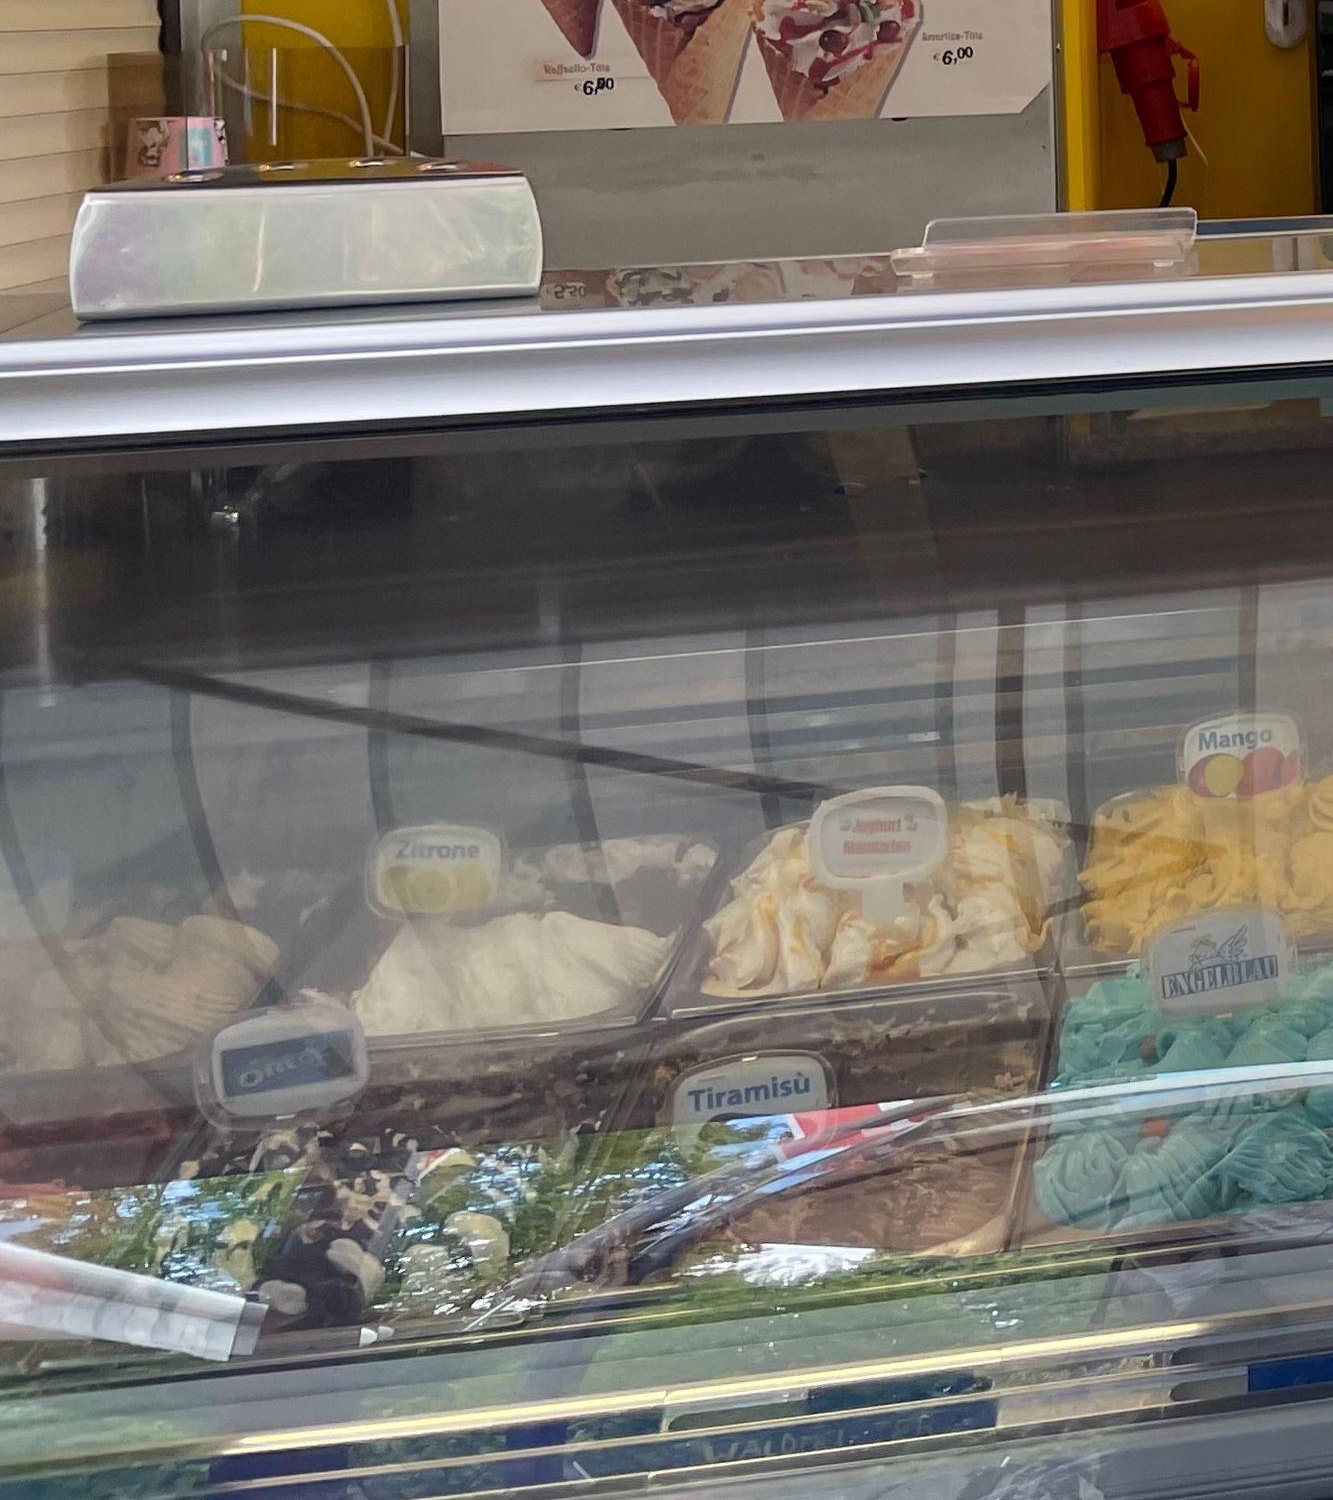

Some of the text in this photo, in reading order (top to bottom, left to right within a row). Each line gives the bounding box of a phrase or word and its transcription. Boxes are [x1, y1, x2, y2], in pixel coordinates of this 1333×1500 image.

[1198, 725, 1274, 754] Mango
[394, 838, 482, 861] Zitrone
[1161, 954, 1279, 999] ENGELBLAU
[687, 1071, 812, 1113] Tiramisù
